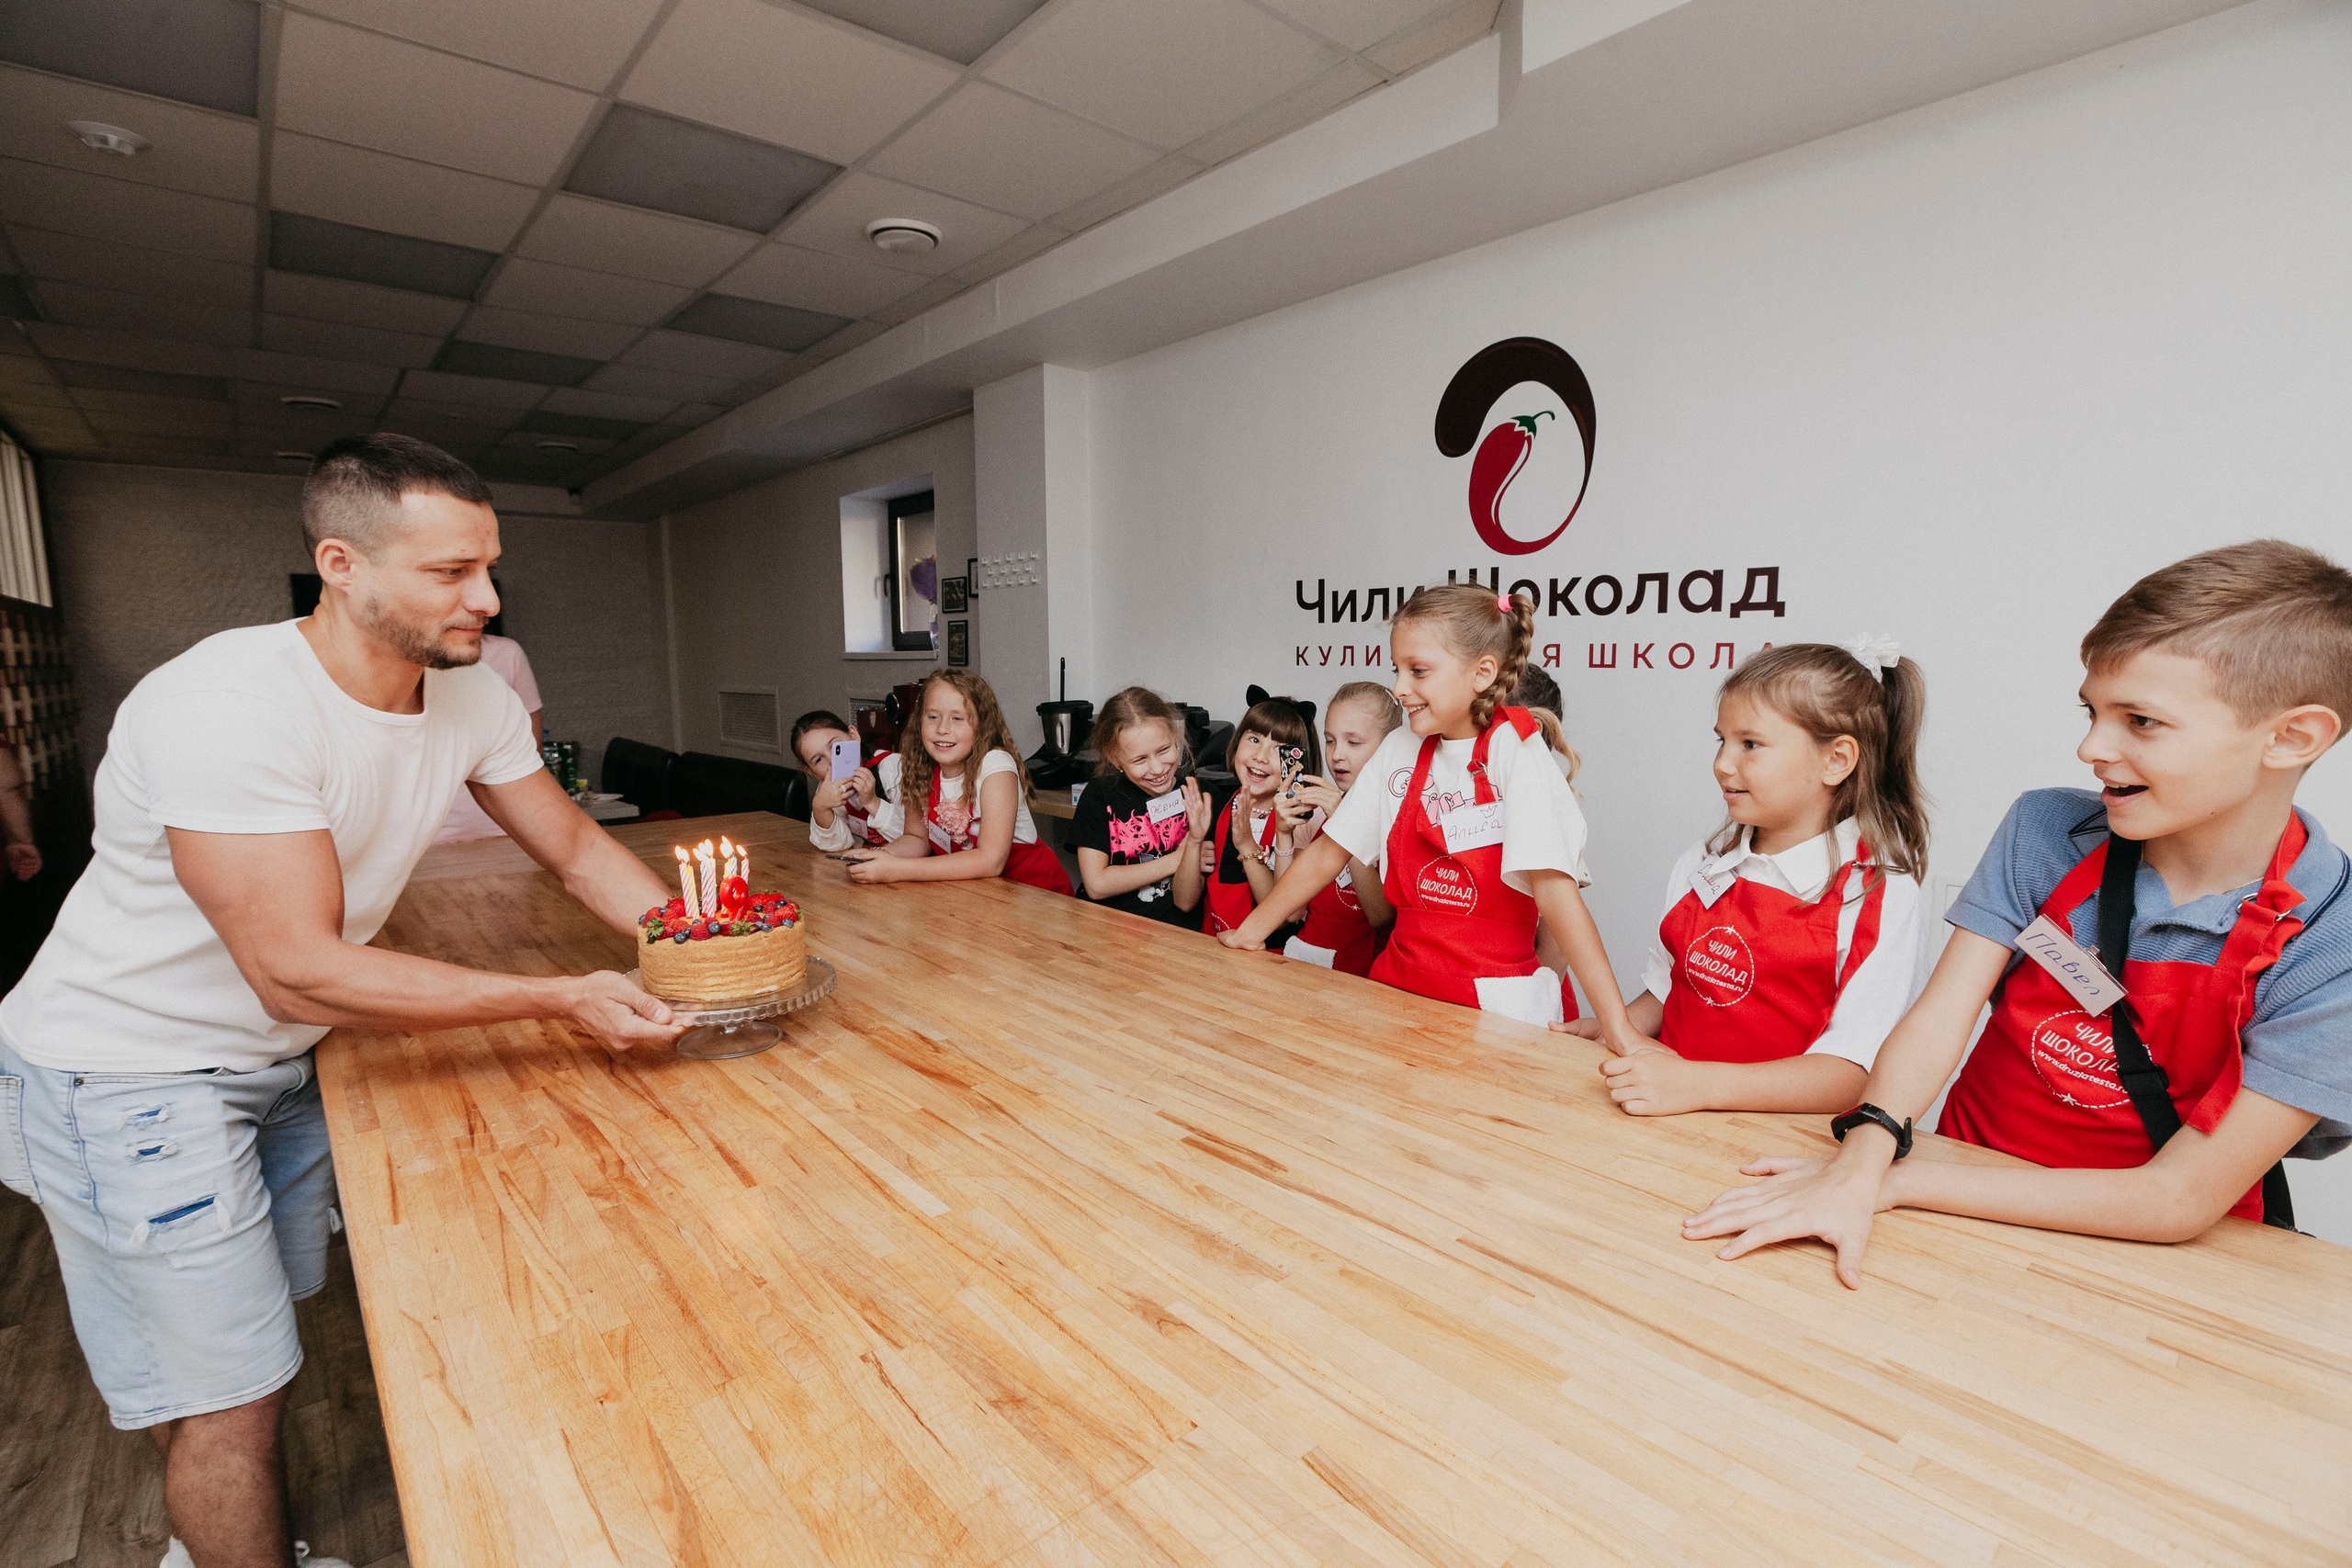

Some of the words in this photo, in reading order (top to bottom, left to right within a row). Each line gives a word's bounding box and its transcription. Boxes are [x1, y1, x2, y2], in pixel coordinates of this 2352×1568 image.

[1295, 643, 1562, 668] КУЛИЯ
[1588, 642, 1774, 670] ШКОЛ
[1435, 866, 1460, 883] ЧИЛИ
[1419, 880, 1473, 901] ШОКОЛАД
[1708, 939, 1738, 961] ЧИЛИ
[2025, 931, 2101, 997] Павел
[1689, 950, 1748, 986] ШОКОЛАД
[2040, 1029, 2120, 1077] ШОКОЛА
